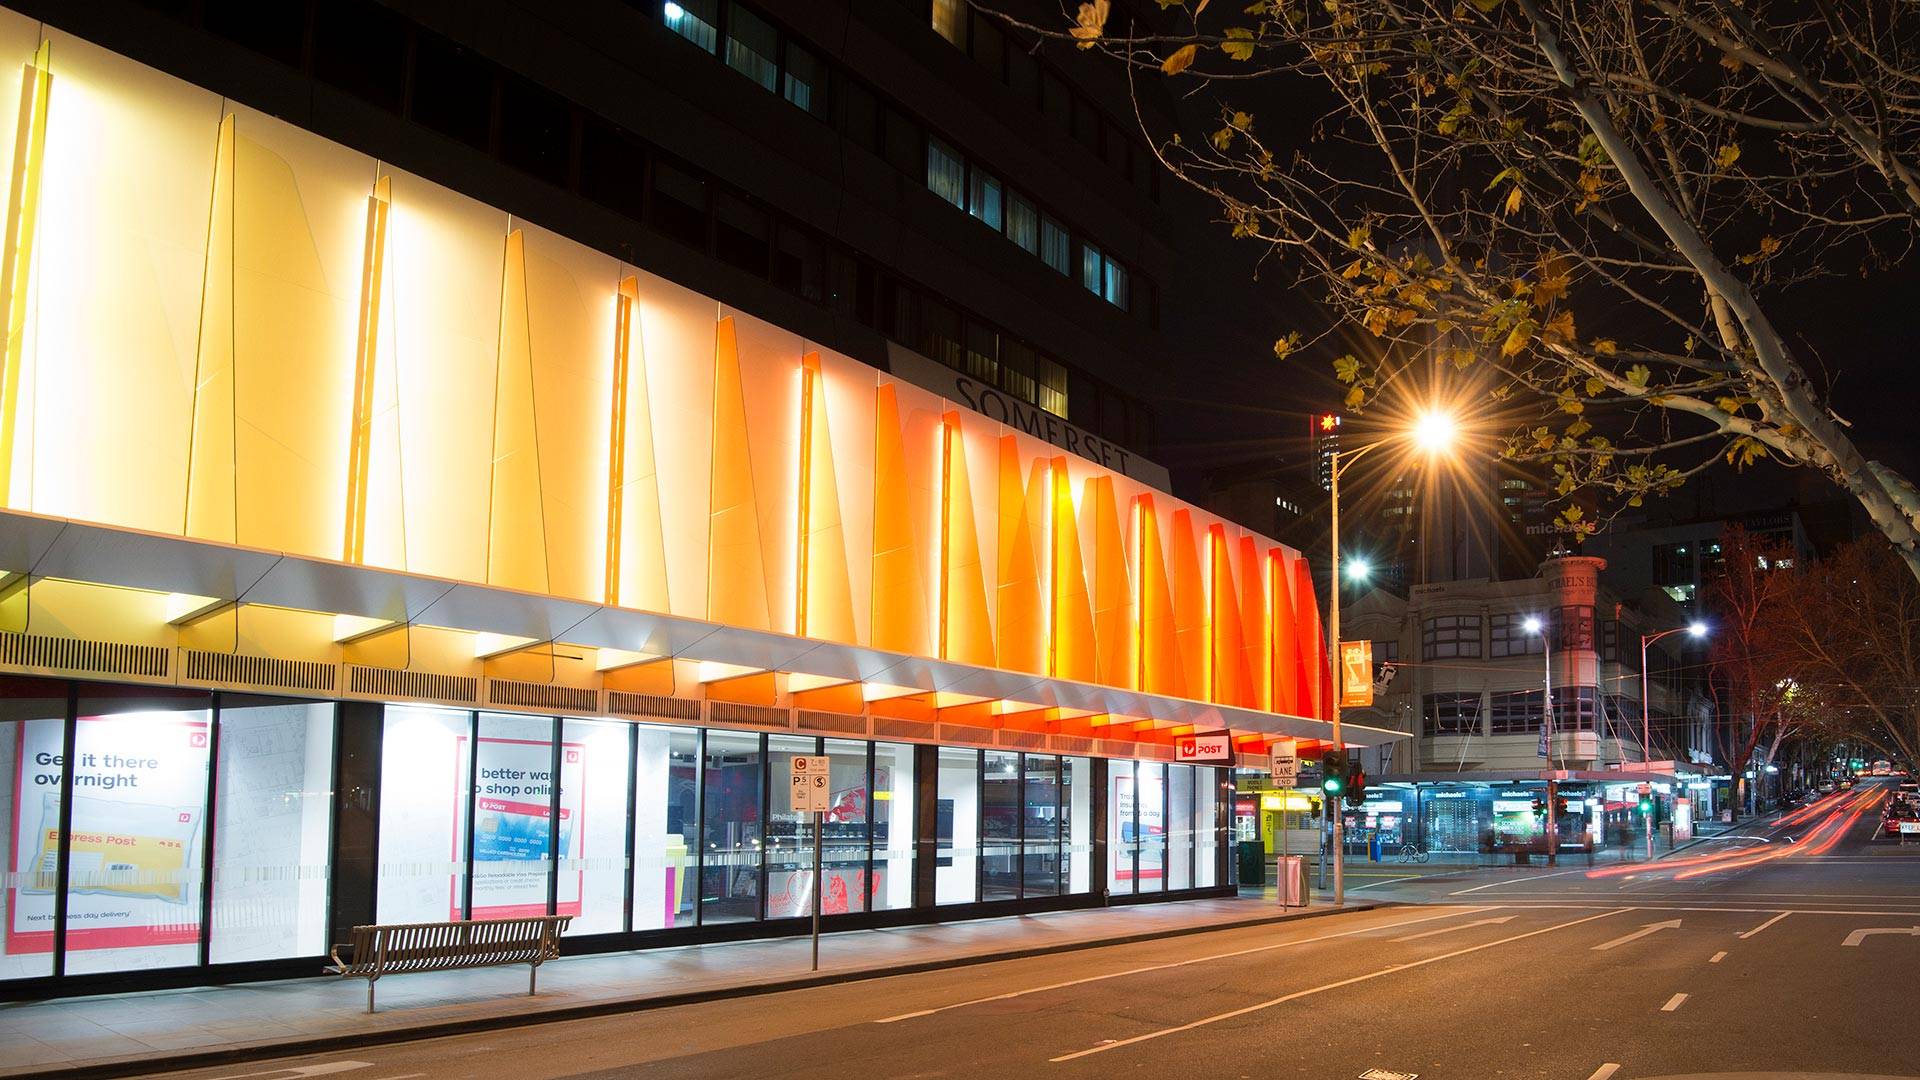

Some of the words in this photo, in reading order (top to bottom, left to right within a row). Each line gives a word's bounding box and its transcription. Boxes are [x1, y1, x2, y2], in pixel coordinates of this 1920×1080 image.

[956, 377, 1129, 476] SOMERSET
[1198, 745, 1222, 754] POST
[35, 751, 66, 767] Ge
[82, 752, 97, 767] it
[103, 753, 159, 769] there
[481, 768, 526, 781] better
[1275, 766, 1293, 776] LANE
[34, 773, 138, 789] ovrnight
[486, 783, 521, 797] shop
[106, 835, 137, 847] Post
[27, 913, 46, 922] Next
[83, 912, 100, 921] day
